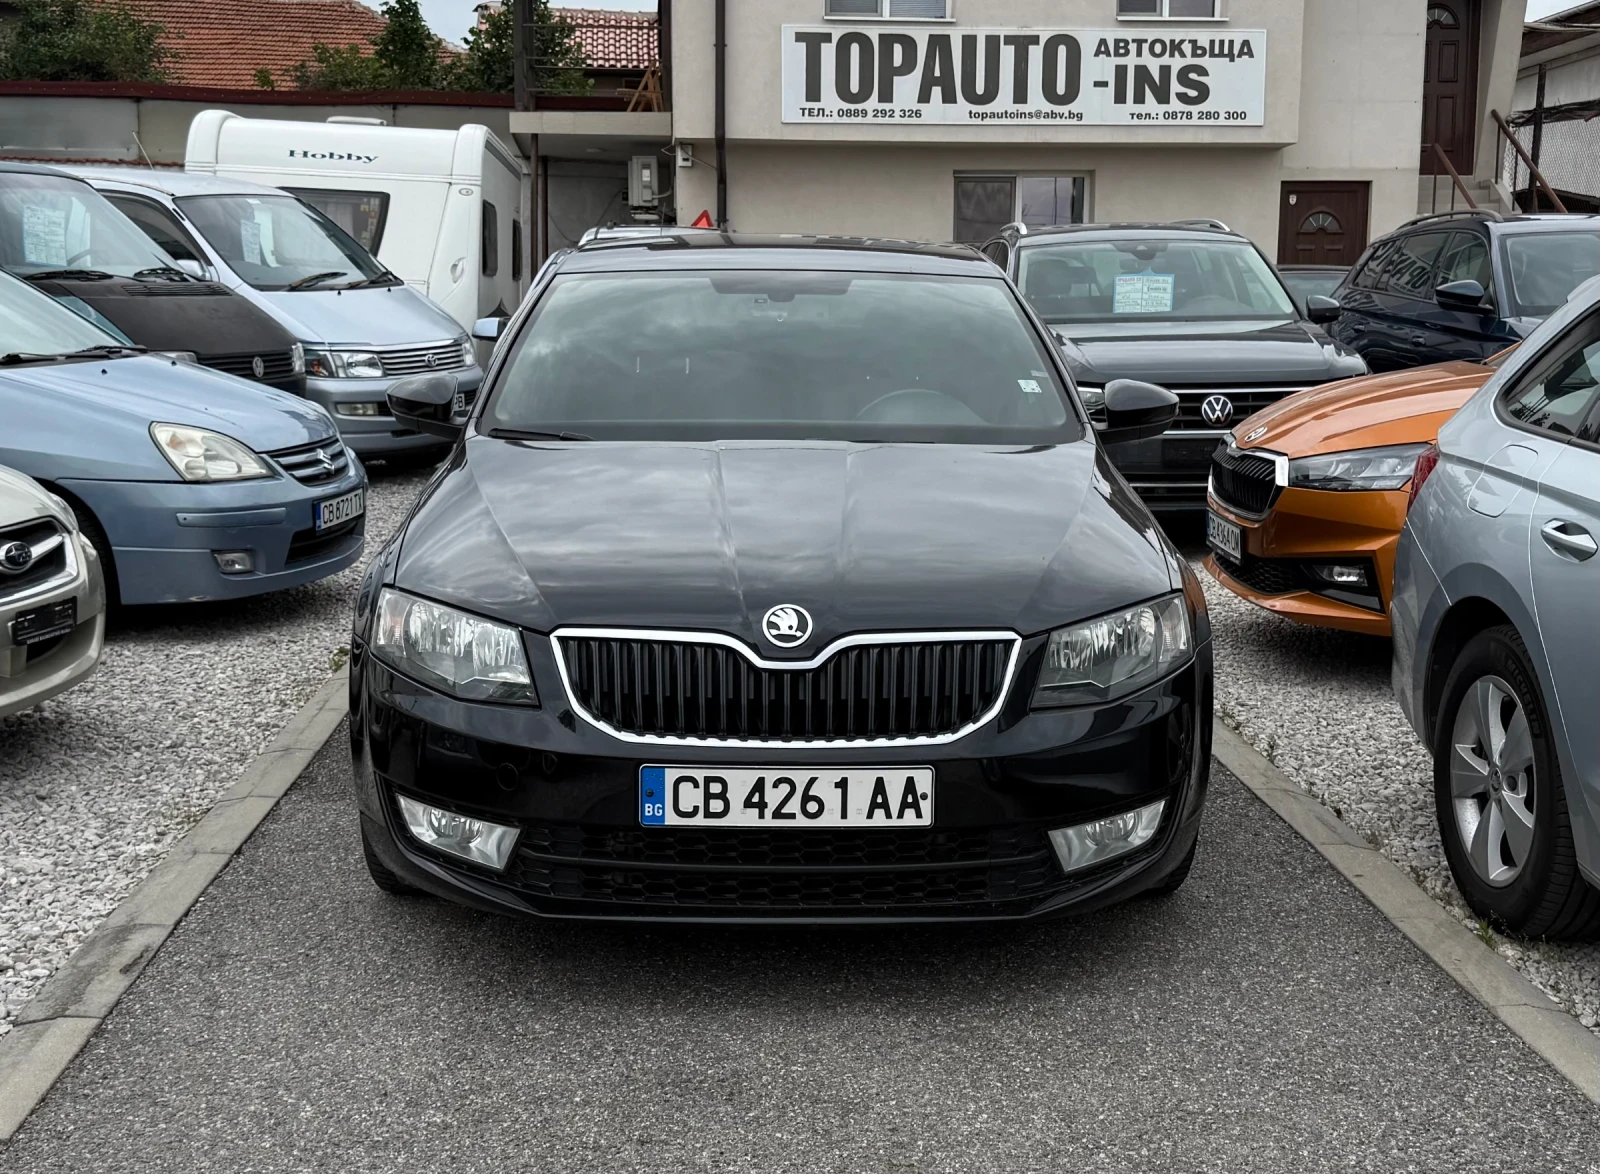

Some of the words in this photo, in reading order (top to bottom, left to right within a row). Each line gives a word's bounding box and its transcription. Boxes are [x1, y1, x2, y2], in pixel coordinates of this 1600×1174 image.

[1093, 38, 1254, 62] АВТОКЪЩА
[795, 32, 1082, 105] TOPAUTO
[1093, 64, 1210, 106] -INS
[799, 107, 833, 118] ТЕЛ.:
[837, 108, 868, 118] 0889
[872, 109, 895, 119] 292
[899, 109, 922, 119] 326
[968, 109, 1083, 122] topautoins@abv.bg
[1129, 112, 1159, 120] тел.:
[1162, 111, 1193, 121] 0878
[1197, 111, 1220, 121] 280
[1223, 111, 1247, 121] 300
[288, 149, 378, 164] Hobby
[323, 504, 334, 524] CB
[336, 496, 352, 520] 8721
[672, 775, 731, 819] CB
[743, 776, 848, 820] 4261
[866, 776, 923, 820] AA
[644, 804, 663, 817] BG
